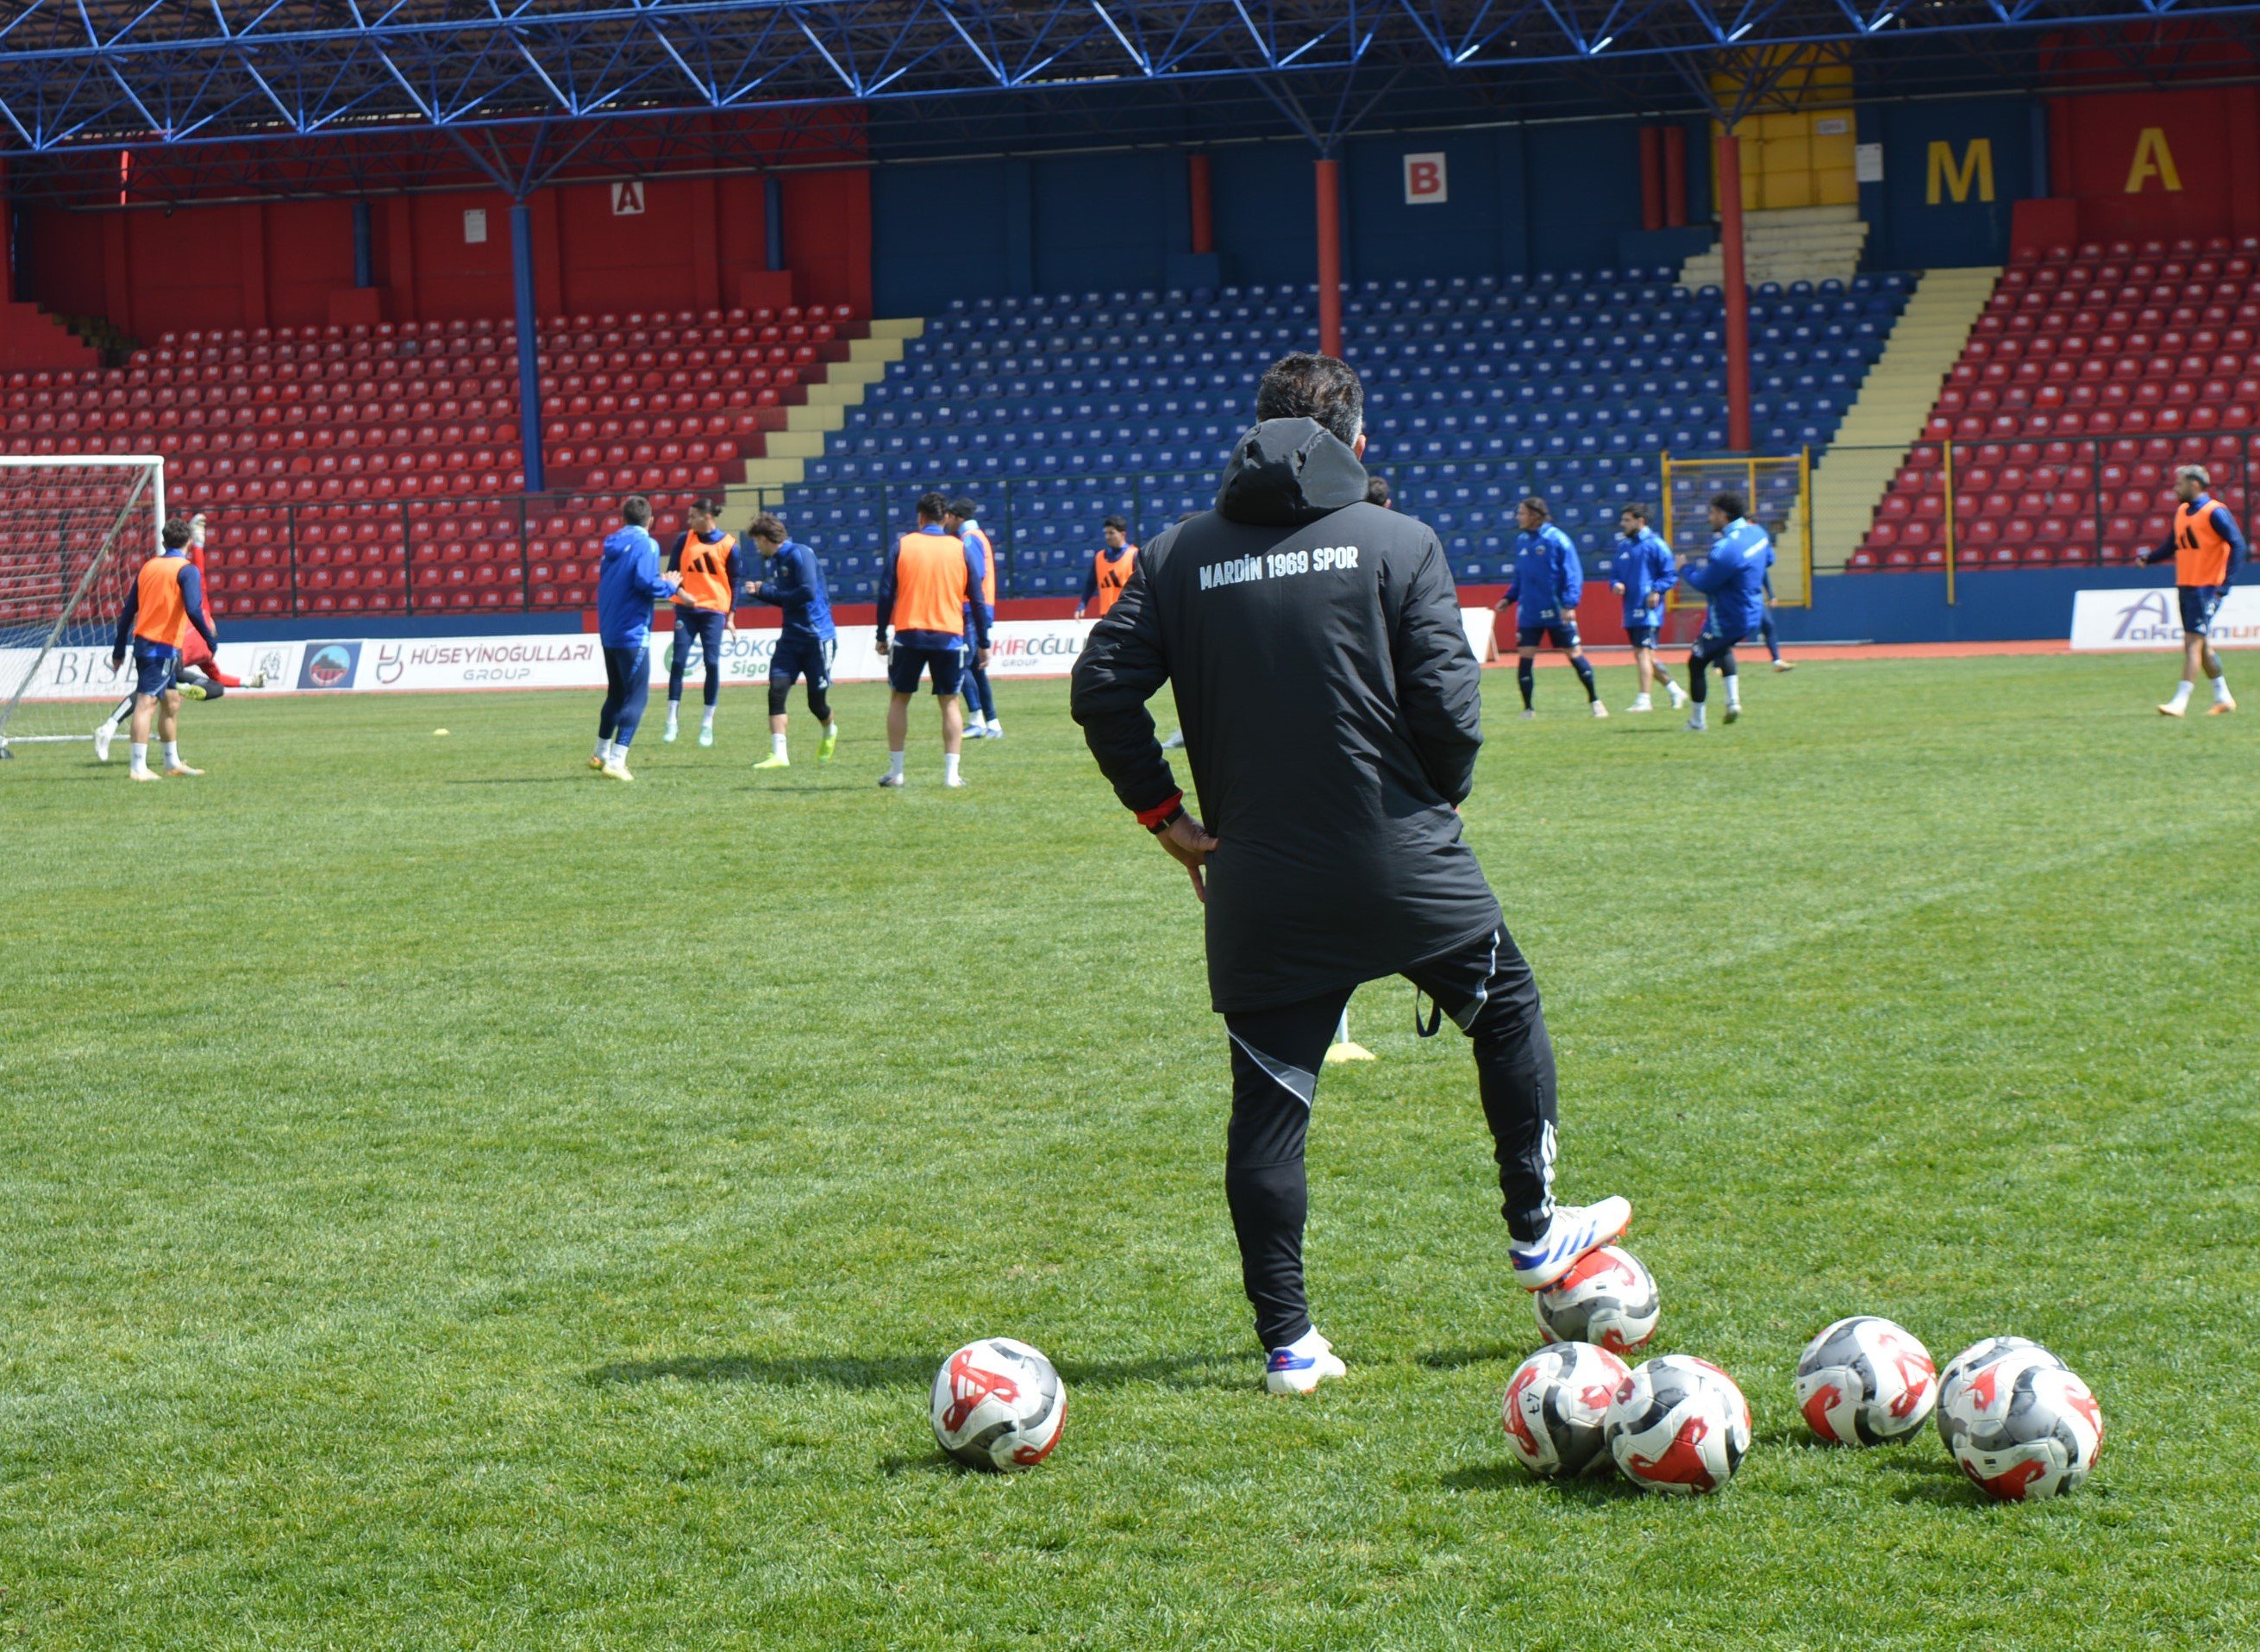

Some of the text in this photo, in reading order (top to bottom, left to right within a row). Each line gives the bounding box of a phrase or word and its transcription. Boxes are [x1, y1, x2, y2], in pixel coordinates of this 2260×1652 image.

[1410, 162, 1440, 196] B
[1926, 138, 1994, 204] M
[2124, 128, 2182, 193] A
[617, 182, 642, 212] A
[1199, 546, 1359, 591] MARDİN 1969 SPOR
[463, 668, 531, 681] GROUP
